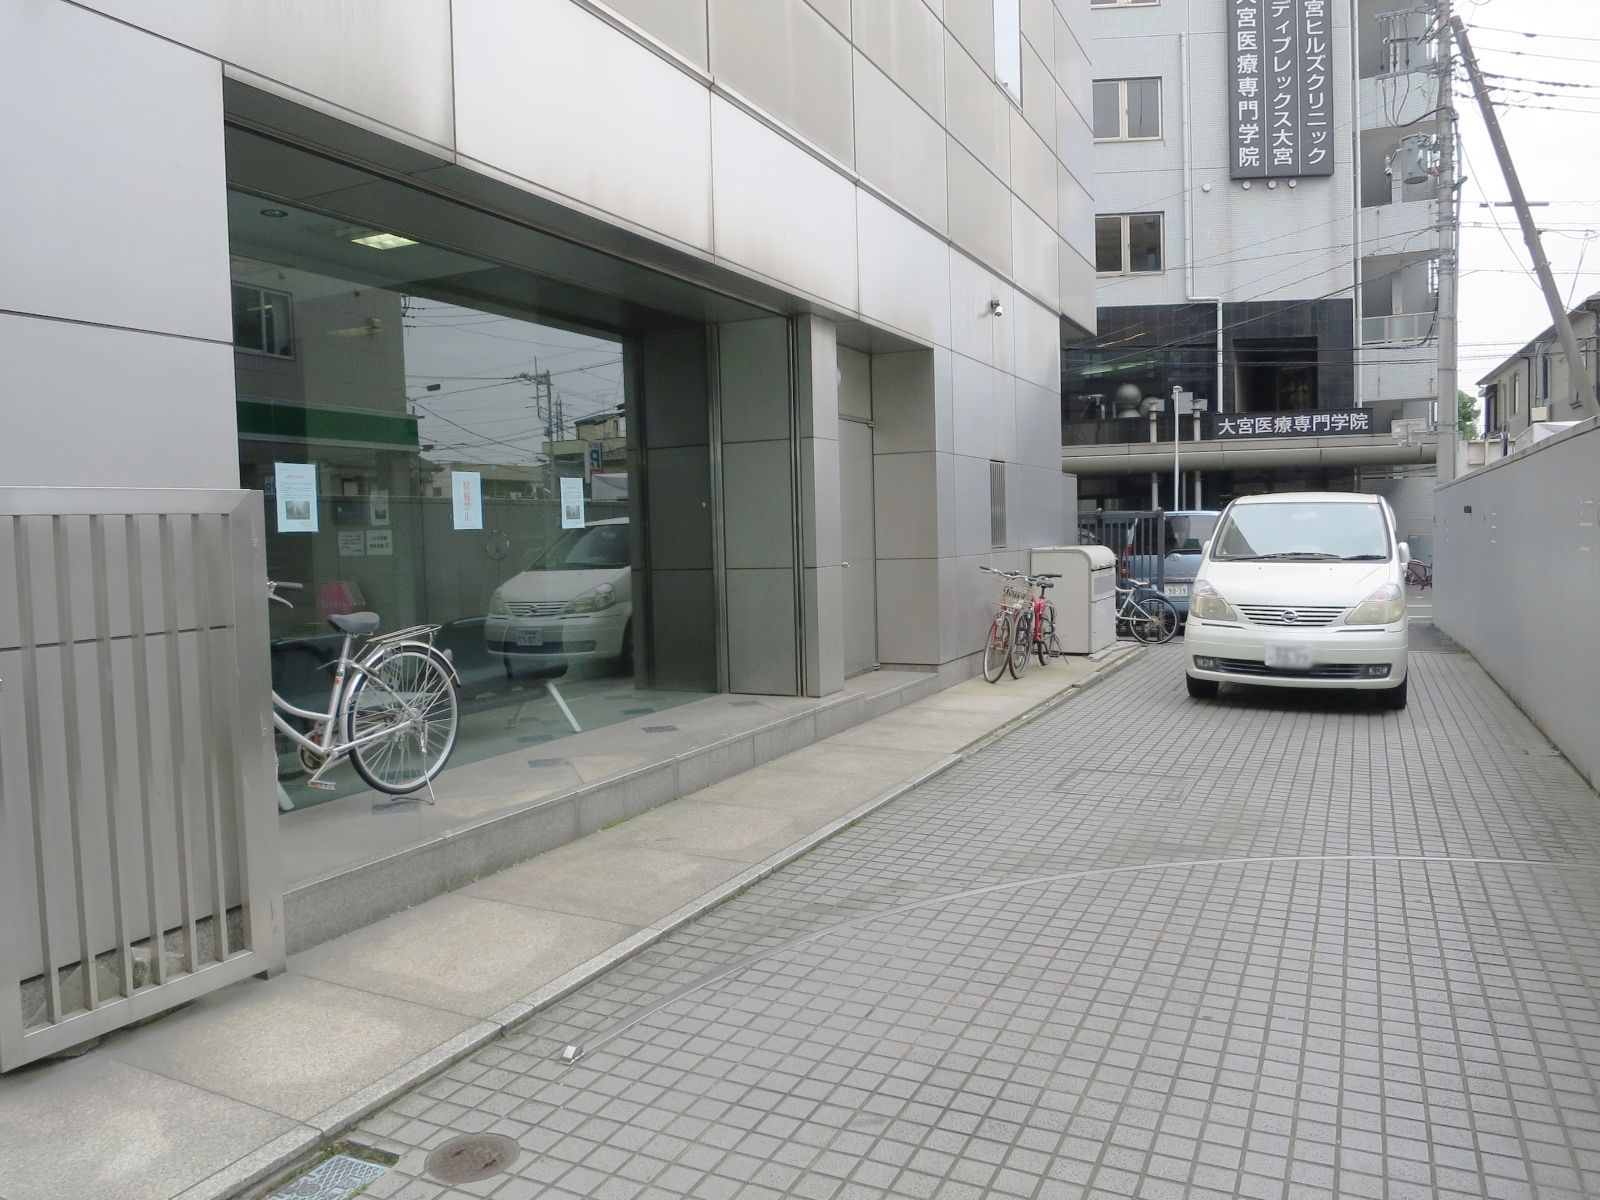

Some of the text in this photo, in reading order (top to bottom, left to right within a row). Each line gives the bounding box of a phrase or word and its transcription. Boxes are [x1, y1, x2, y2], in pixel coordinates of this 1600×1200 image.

[1236, 0, 1259, 167] 宮医療専門学院
[1271, 0, 1293, 165] ディプレックス大宮
[1304, 0, 1326, 164] 宮ヒルズクリニック
[1218, 413, 1368, 435] 大宮医療専門学院
